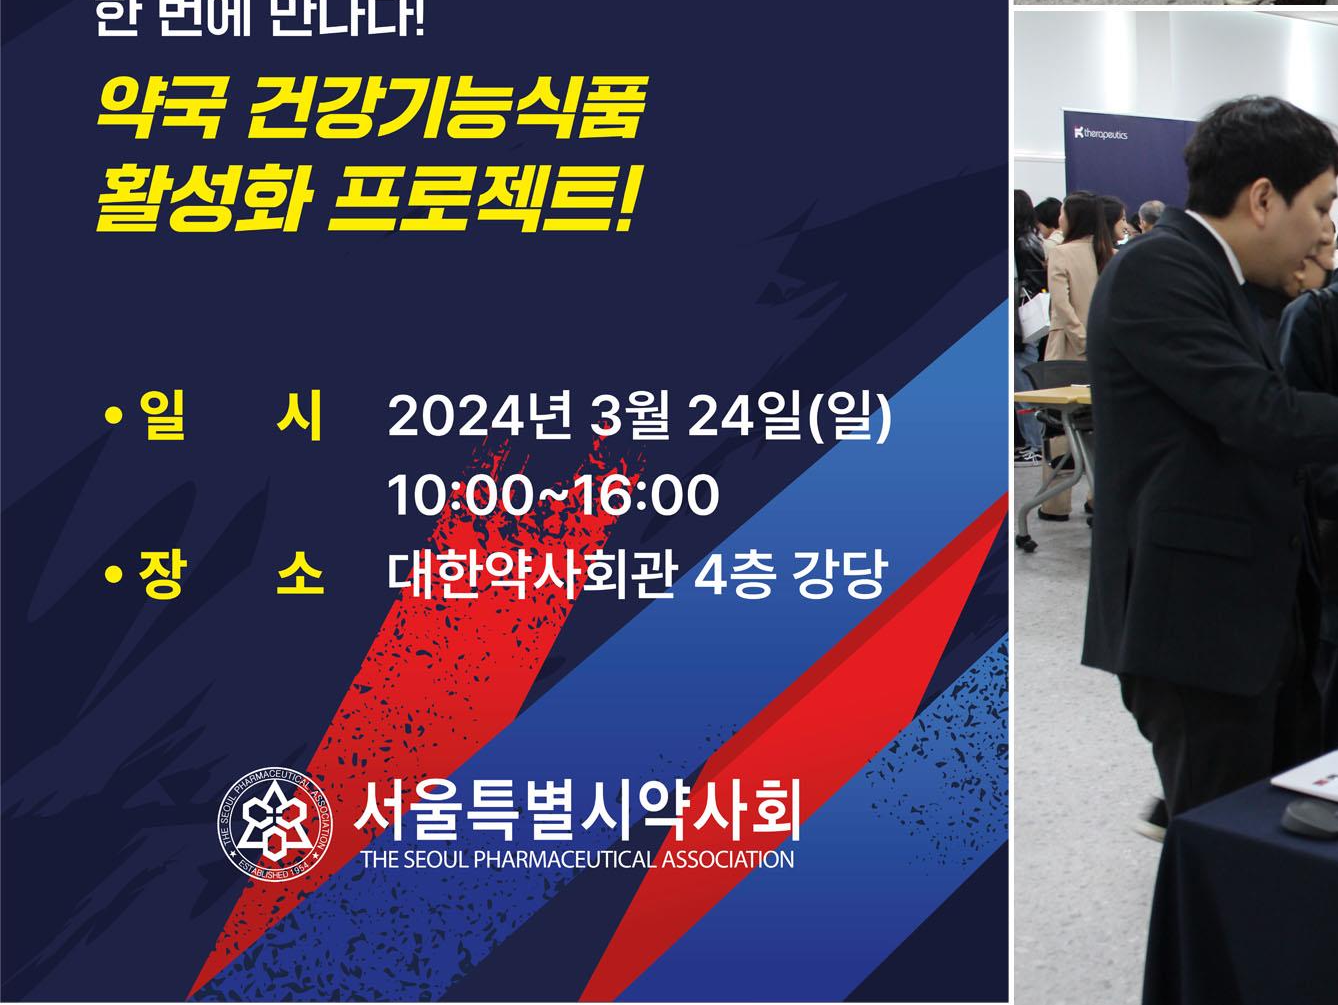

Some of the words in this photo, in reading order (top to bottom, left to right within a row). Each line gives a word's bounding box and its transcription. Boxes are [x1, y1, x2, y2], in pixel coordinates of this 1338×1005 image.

[96, 75, 230, 139] 약국
[247, 75, 649, 139] 건강기능식품
[96, 163, 314, 233] 활성화
[327, 163, 645, 233] 프로젝트!
[139, 390, 187, 441] 일
[276, 390, 323, 441] 시
[387, 391, 572, 441] 2024년
[589, 391, 671, 441] 3월
[687, 390, 893, 444] 24일(일)
[387, 472, 720, 517] 10:00~16:00
[139, 549, 187, 601] 장
[276, 552, 325, 596] 소
[387, 549, 678, 601] 대한약사회관
[694, 549, 778, 601] 4층
[792, 549, 889, 601] 강당
[234, 770, 311, 794] PHARMACEUTICAL
[353, 777, 802, 843] 서울특별시약사회
[238, 859, 289, 879] ESTABLISHED
[360, 851, 401, 869] THE
[404, 851, 468, 869] SEOUL
[472, 851, 657, 869] PHARMACEUTICAL
[661, 851, 796, 869] ASSOCIATION
